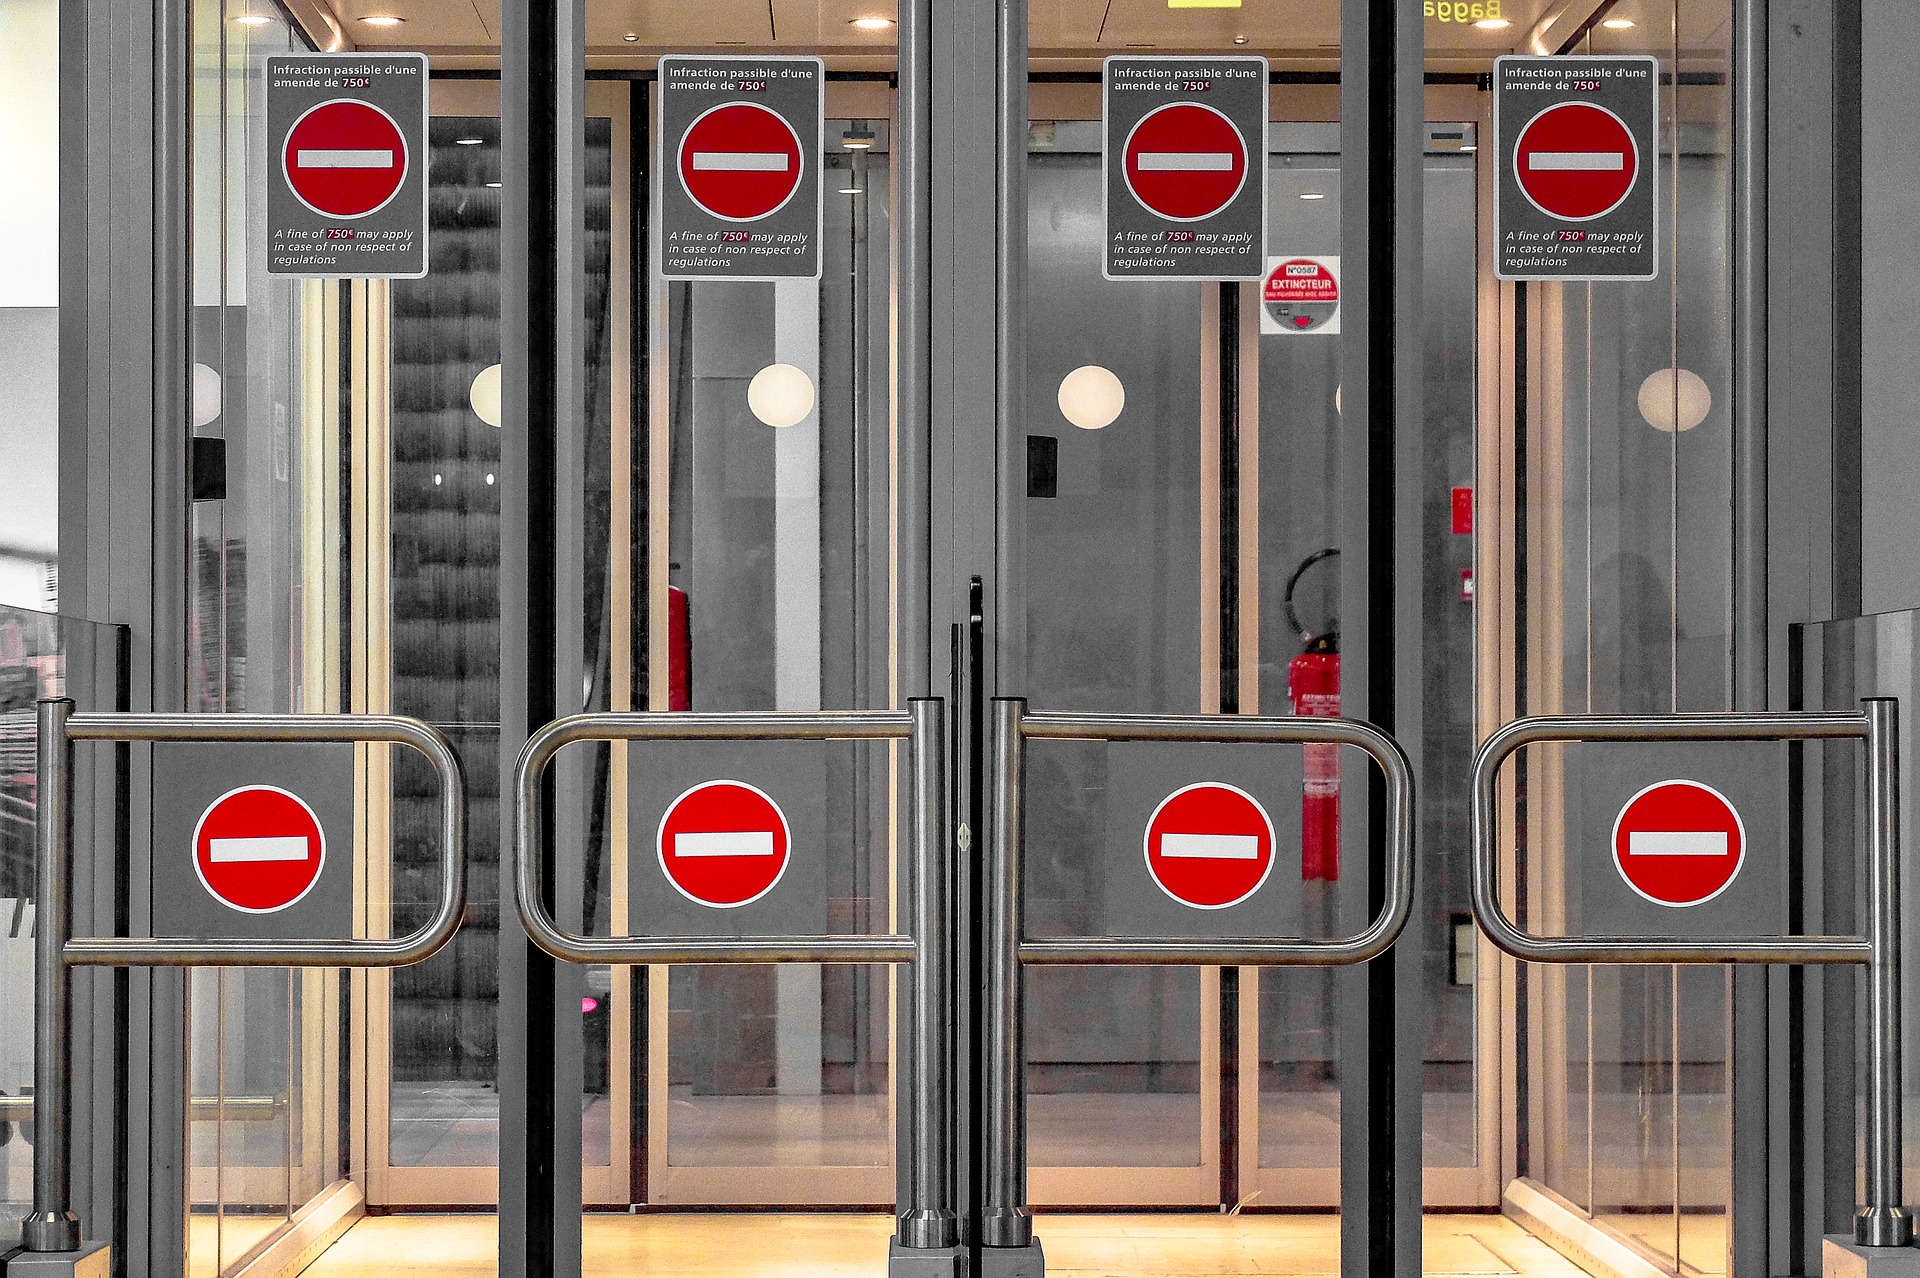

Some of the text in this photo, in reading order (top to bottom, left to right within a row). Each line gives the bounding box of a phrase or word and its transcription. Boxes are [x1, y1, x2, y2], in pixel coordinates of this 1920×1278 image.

[273, 64, 419, 77] Infraction passible d'une
[669, 66, 813, 79] Infraction passible d'une
[1114, 67, 1257, 79] Infraction passible d'une
[1505, 67, 1647, 79] Infraction passible d'une
[273, 77, 321, 88] amende
[323, 77, 339, 88] de
[669, 80, 717, 91] amende
[720, 80, 735, 91] de
[1114, 80, 1162, 91] amende
[1164, 80, 1180, 91] de
[1505, 80, 1552, 91] amende
[1555, 80, 1570, 91] de
[273, 229, 283, 240] A
[286, 228, 309, 240] fine
[311, 228, 325, 240] of
[355, 230, 380, 242] may
[382, 228, 414, 242] apply
[668, 231, 678, 241] A
[681, 230, 703, 241] fine
[706, 231, 720, 241] of
[750, 233, 775, 244] may
[776, 232, 809, 244] apply
[1113, 231, 1123, 241] A
[1126, 230, 1148, 241] fine
[1151, 230, 1165, 242] of
[1195, 233, 1219, 244] may
[1221, 231, 1253, 244] apply
[1505, 231, 1515, 241] A
[1518, 230, 1540, 241] fine
[1542, 230, 1556, 241] of
[1587, 233, 1611, 243] may
[1612, 230, 1644, 243] apply
[273, 241, 413, 254] in case of non respect of
[668, 243, 807, 257] in case of non respect of
[1113, 243, 1252, 257] in case of non respect of
[1505, 243, 1643, 256] in case of non respect of
[273, 254, 338, 268] regulations
[668, 256, 731, 269] regulations
[1113, 256, 1177, 269] regulations
[1505, 256, 1568, 269] regulations
[1271, 279, 1332, 289] EXTINCTEUR
